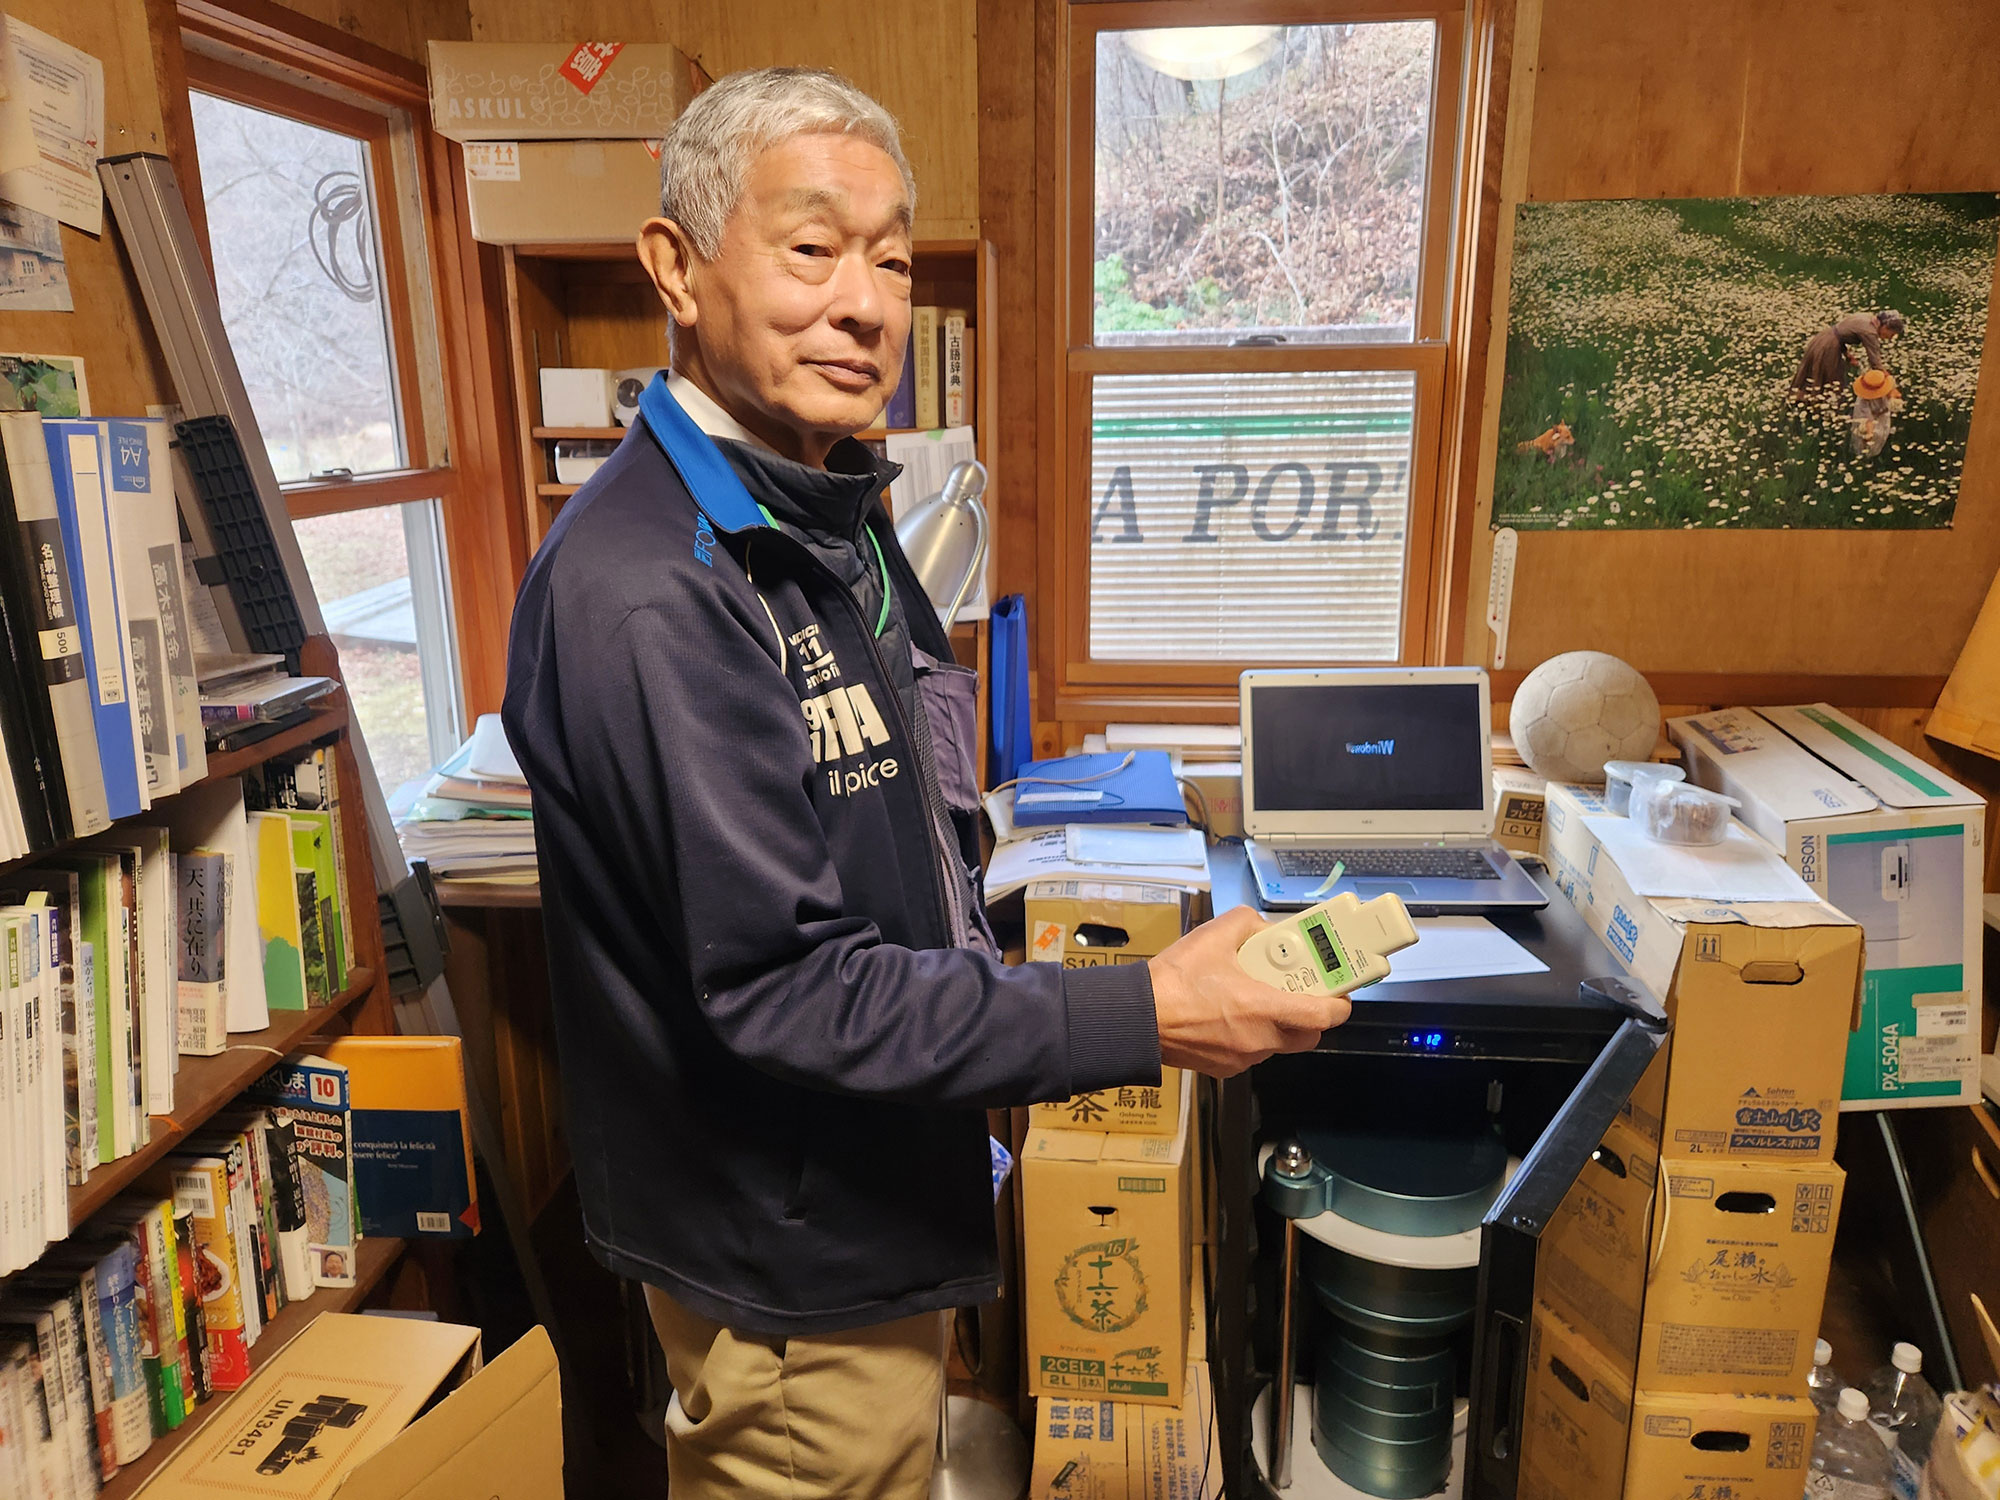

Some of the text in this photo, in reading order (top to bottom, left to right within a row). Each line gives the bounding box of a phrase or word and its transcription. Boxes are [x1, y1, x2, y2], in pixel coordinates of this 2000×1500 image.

[449, 98, 526, 119] ASKUL
[950, 336, 961, 387] 古語辞典
[120, 446, 142, 467] A4
[1182, 460, 1407, 543] POR
[57, 631, 68, 654] 500
[798, 636, 824, 662] 11
[827, 769, 842, 797] il
[1801, 834, 1815, 883] EPSON
[1882, 1023, 1899, 1091] PX-504A
[315, 1076, 335, 1098] 10
[1114, 1086, 1162, 1109] 烏龍
[1737, 1108, 1821, 1131] 富士山のしずく
[400, 1141, 408, 1149] la
[1690, 1143, 1704, 1153] 2L
[1733, 1135, 1817, 1148] ラベルレスボトル
[1106, 1242, 1122, 1255] 16
[1709, 1249, 1766, 1268] 尾瀬の
[1709, 1267, 1774, 1284] おいしい水
[1086, 1254, 1122, 1331] 十六茶
[1046, 1358, 1099, 1374] 2CEL2
[1110, 1361, 1164, 1381] 十六茶
[229, 1399, 294, 1457] UN3481
